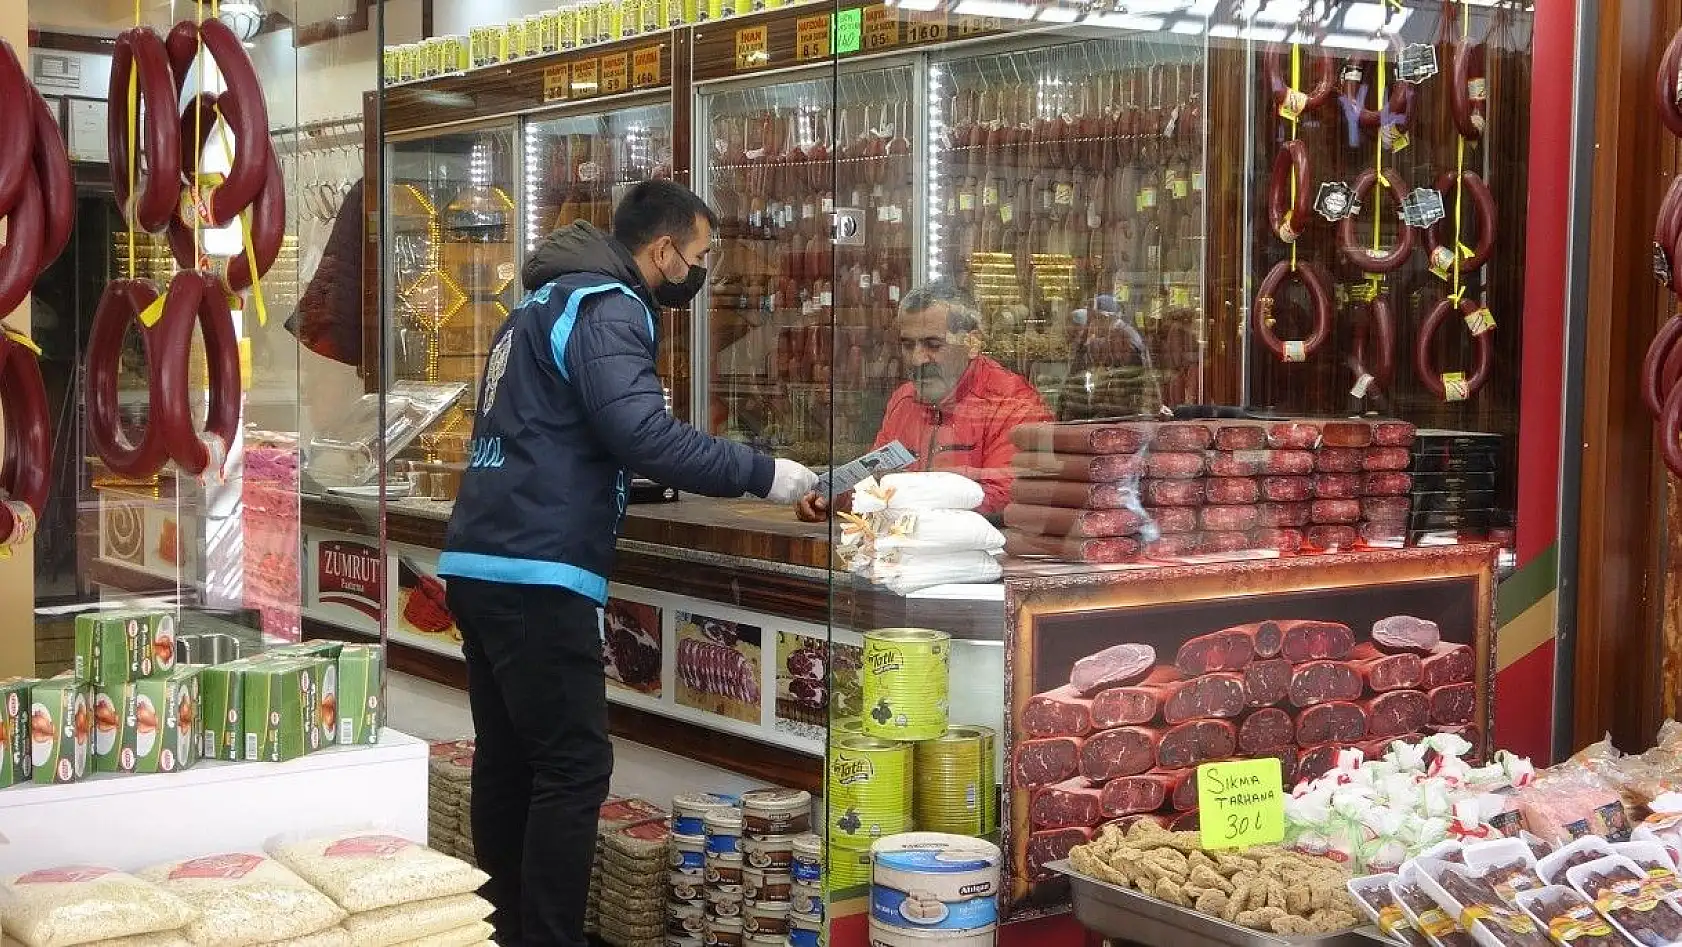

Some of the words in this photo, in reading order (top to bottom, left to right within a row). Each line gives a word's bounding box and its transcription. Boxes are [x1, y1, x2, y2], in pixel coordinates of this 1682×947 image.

[909, 24, 940, 40] 160
[324, 545, 381, 583] ZÜMRÜT
[1213, 790, 1275, 810] TARHANA
[1224, 813, 1250, 839] 30
